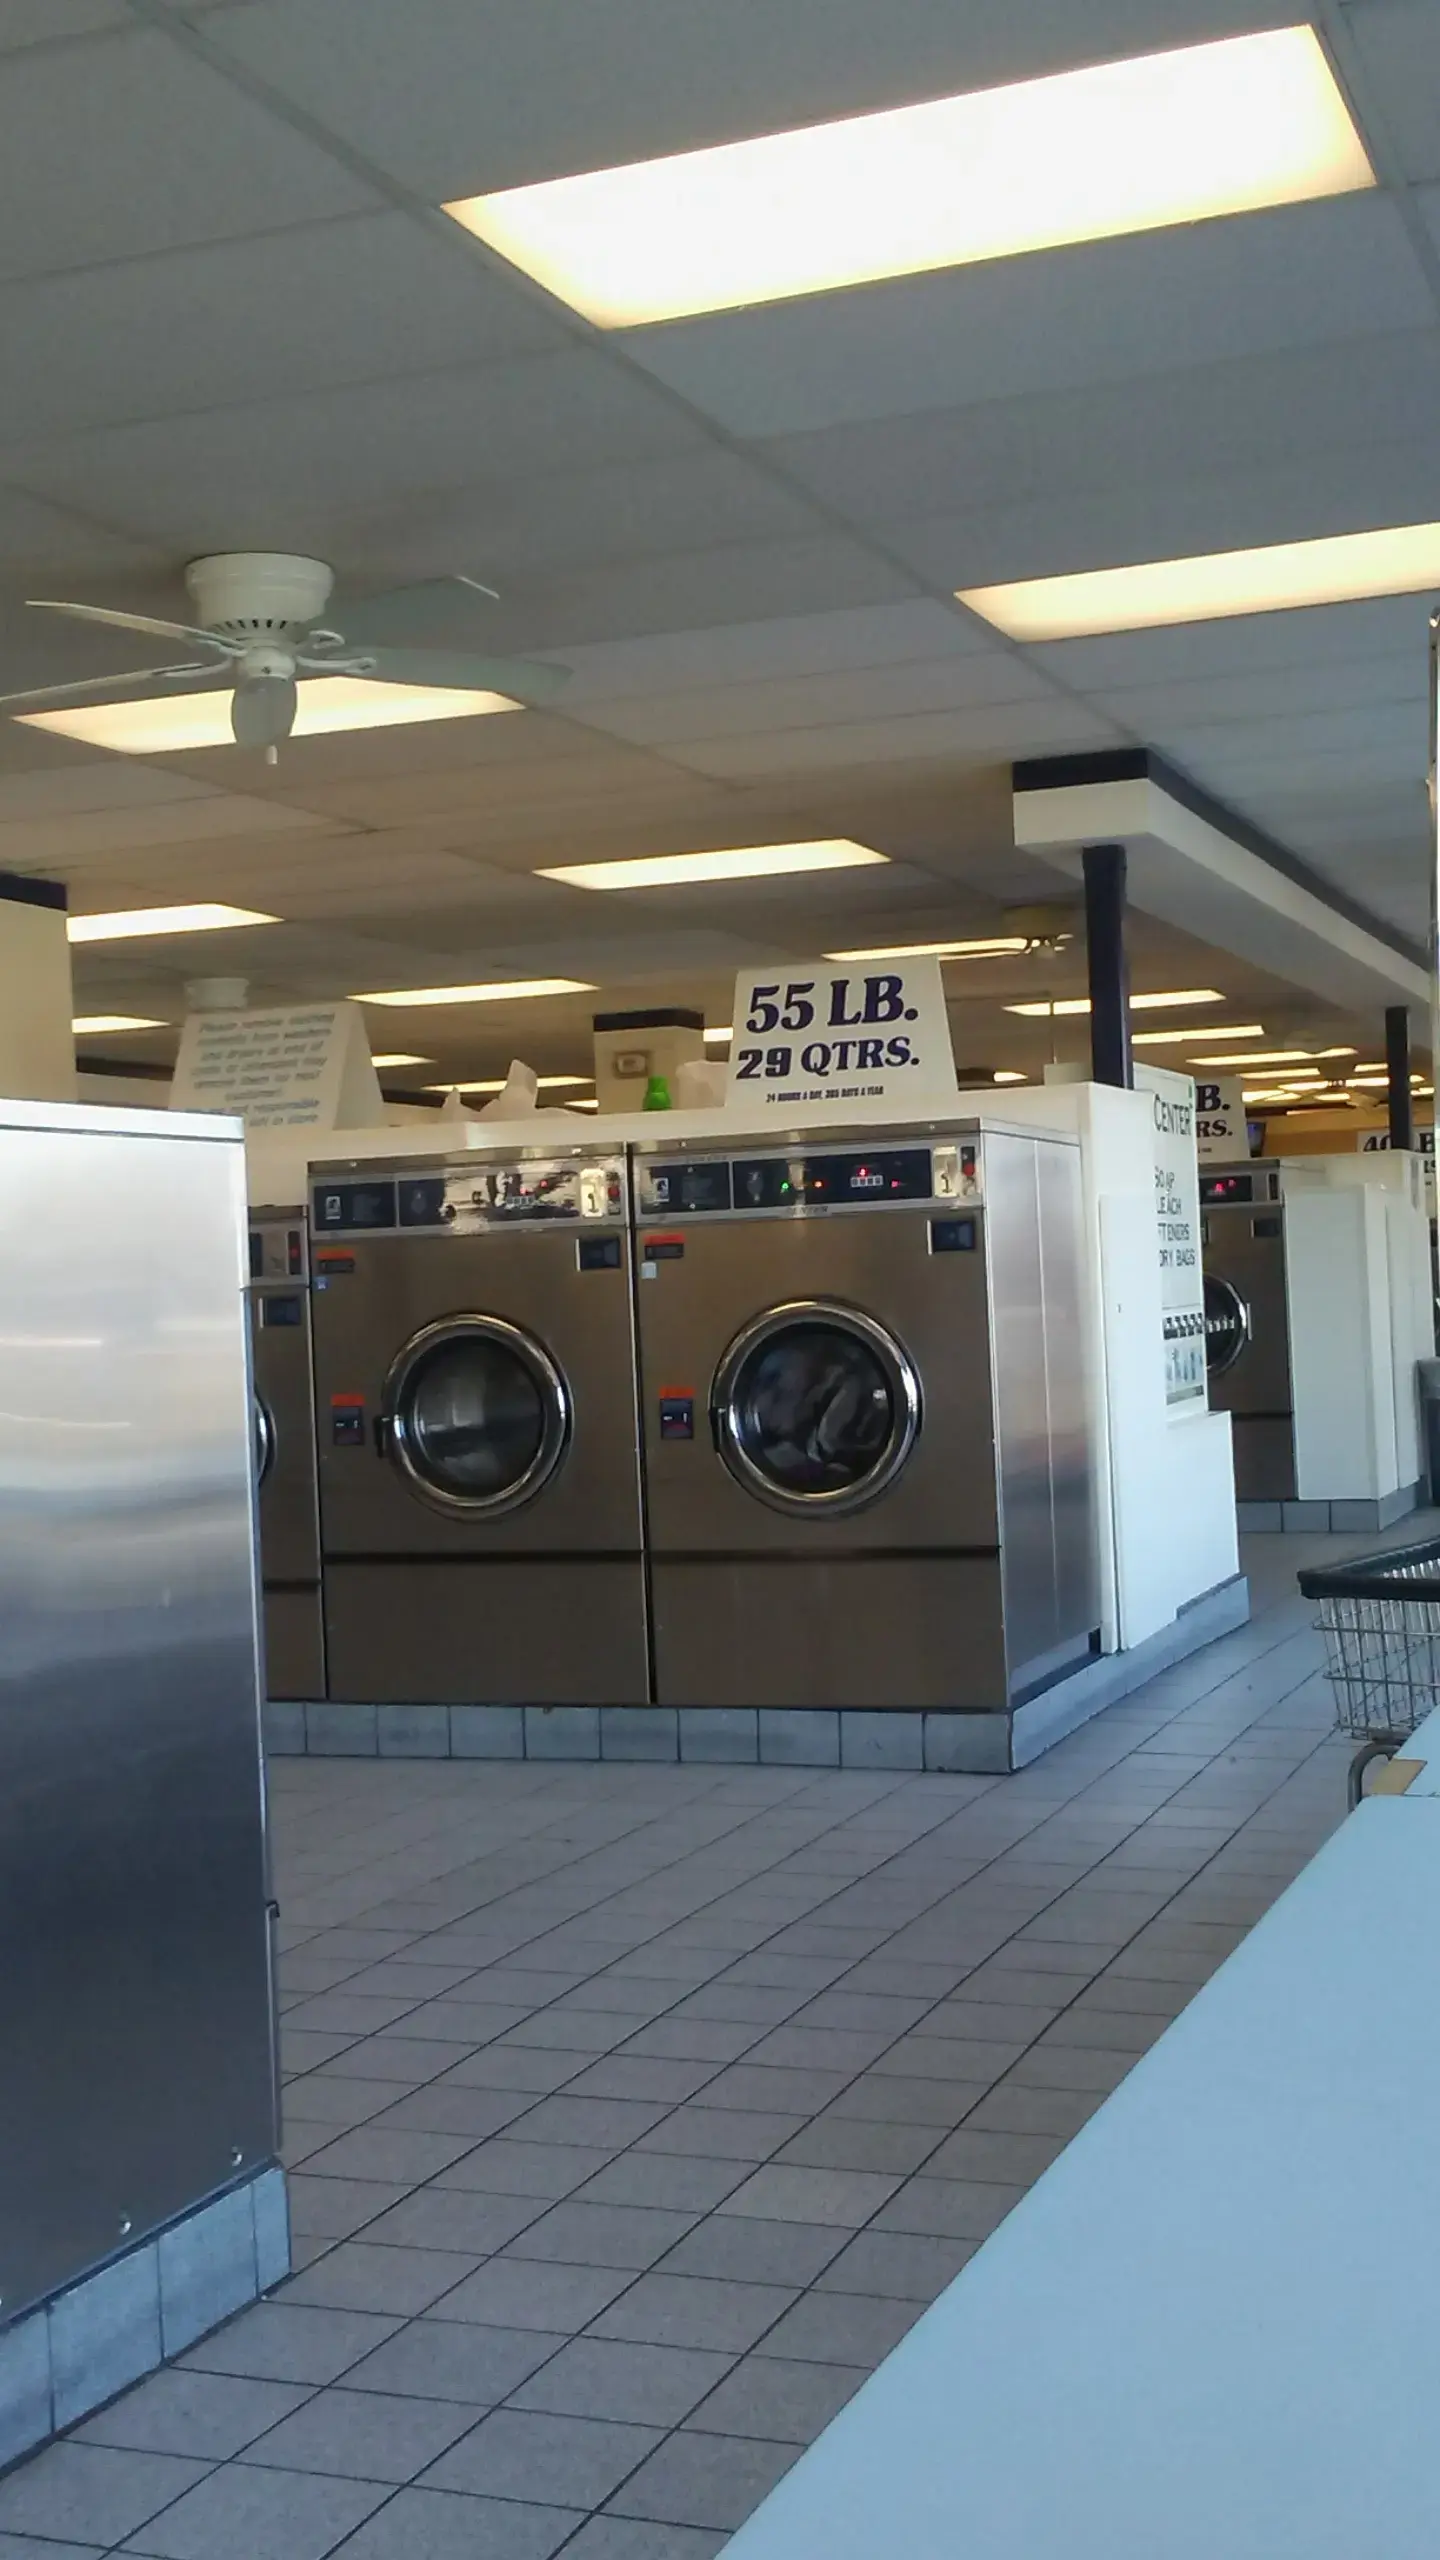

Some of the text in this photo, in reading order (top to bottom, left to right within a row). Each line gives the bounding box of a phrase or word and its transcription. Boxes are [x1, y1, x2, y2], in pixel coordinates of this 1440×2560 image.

[746, 975, 919, 1033] 55 LB.
[736, 1036, 920, 1080] 29 QTRS.
[1153, 1093, 1193, 1136] CENTER
